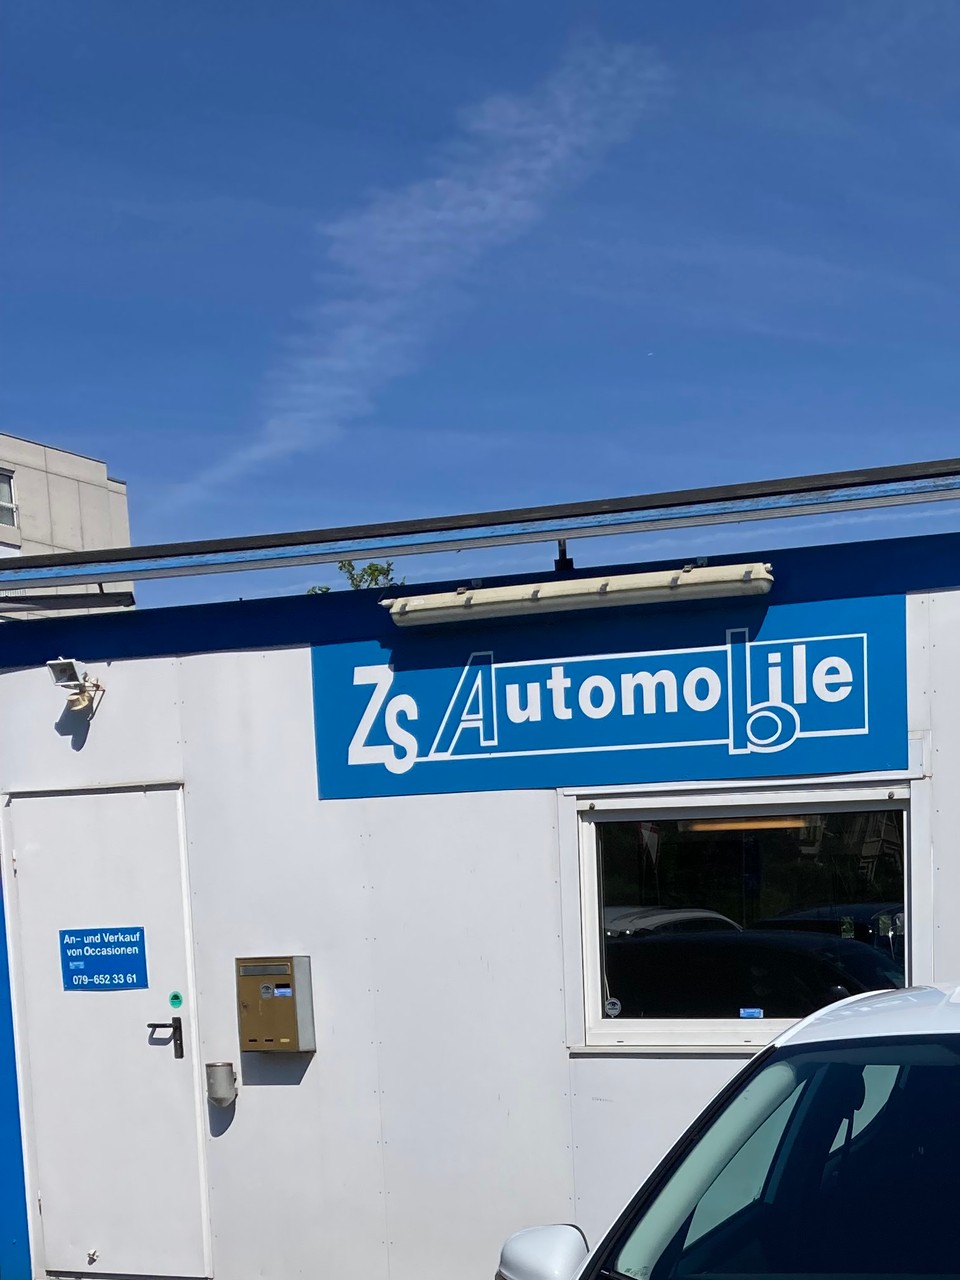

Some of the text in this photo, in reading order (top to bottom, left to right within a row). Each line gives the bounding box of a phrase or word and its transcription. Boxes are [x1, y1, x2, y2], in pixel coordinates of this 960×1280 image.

[428, 628, 854, 756] Automobile
[63, 932, 141, 944] An- und Verkauf
[66, 945, 139, 957] von Occasionen
[72, 974, 137, 985] 079-652 33 61
